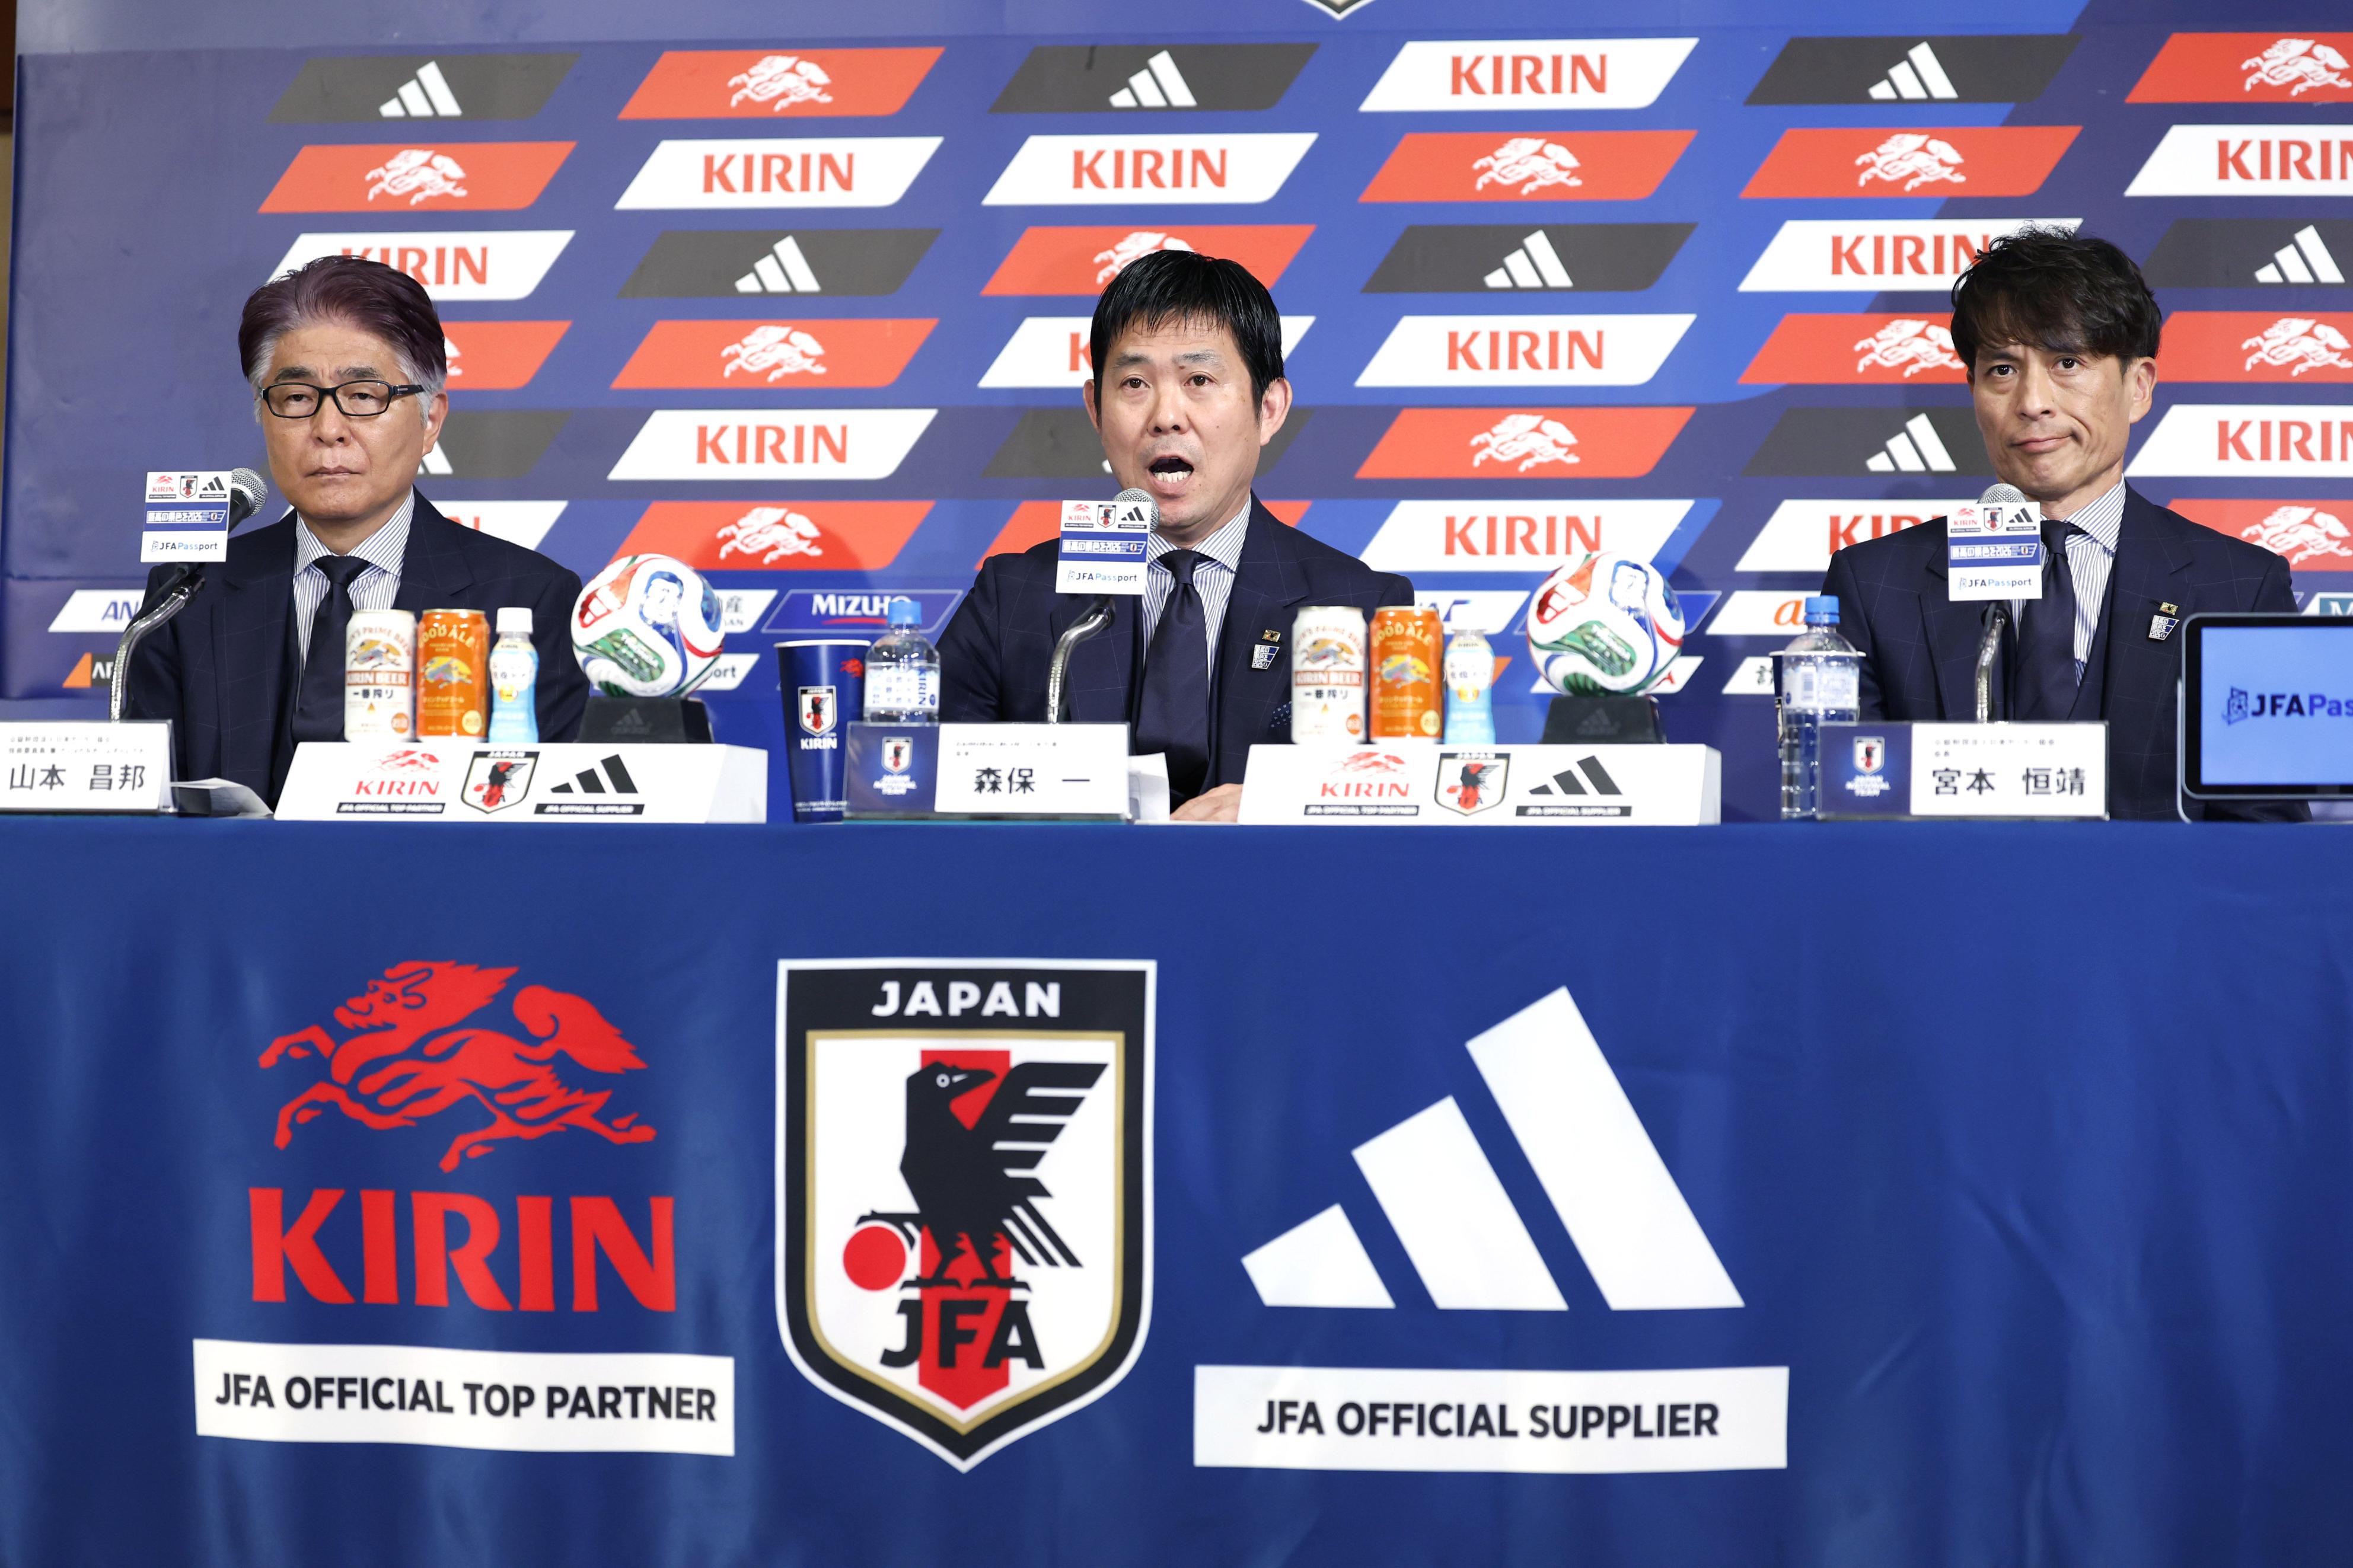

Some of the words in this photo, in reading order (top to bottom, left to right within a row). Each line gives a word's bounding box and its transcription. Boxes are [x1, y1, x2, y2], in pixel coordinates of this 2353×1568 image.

[1451, 55, 1606, 95] KIRIN
[703, 152, 854, 193] KIRIN
[1072, 149, 1227, 189] KIRIN
[1832, 235, 1990, 275] KIRIN
[1447, 331, 1603, 370] KIRIN
[696, 425, 847, 464] KIRIN
[1445, 516, 1601, 556] KIRIN
[101, 601, 139, 620] AN
[812, 593, 912, 616] MIZUH
[353, 689, 394, 700] 一番搾り
[801, 737, 837, 750] KIRIN
[9, 764, 66, 790] 山本
[90, 764, 145, 790] 昌邦
[355, 780, 439, 796] KIRIN
[974, 767, 1035, 794] 森保
[1321, 783, 1410, 797] KIRIN
[1933, 768, 1995, 795] 宮本
[2022, 768, 2084, 795] 恒靖
[871, 981, 1061, 1018] JAPAN
[248, 1187, 675, 1311] KIRIN
[879, 1298, 1045, 1370] JFA
[215, 1373, 275, 1409] JFA
[285, 1377, 454, 1413] OFFICIAL
[463, 1382, 535, 1418] TOP
[547, 1386, 716, 1422] PARTNER
[1257, 1400, 1325, 1435] JFA
[1337, 1402, 1519, 1437] OFFICIAL
[1529, 1403, 1719, 1439] SUPPLIER
